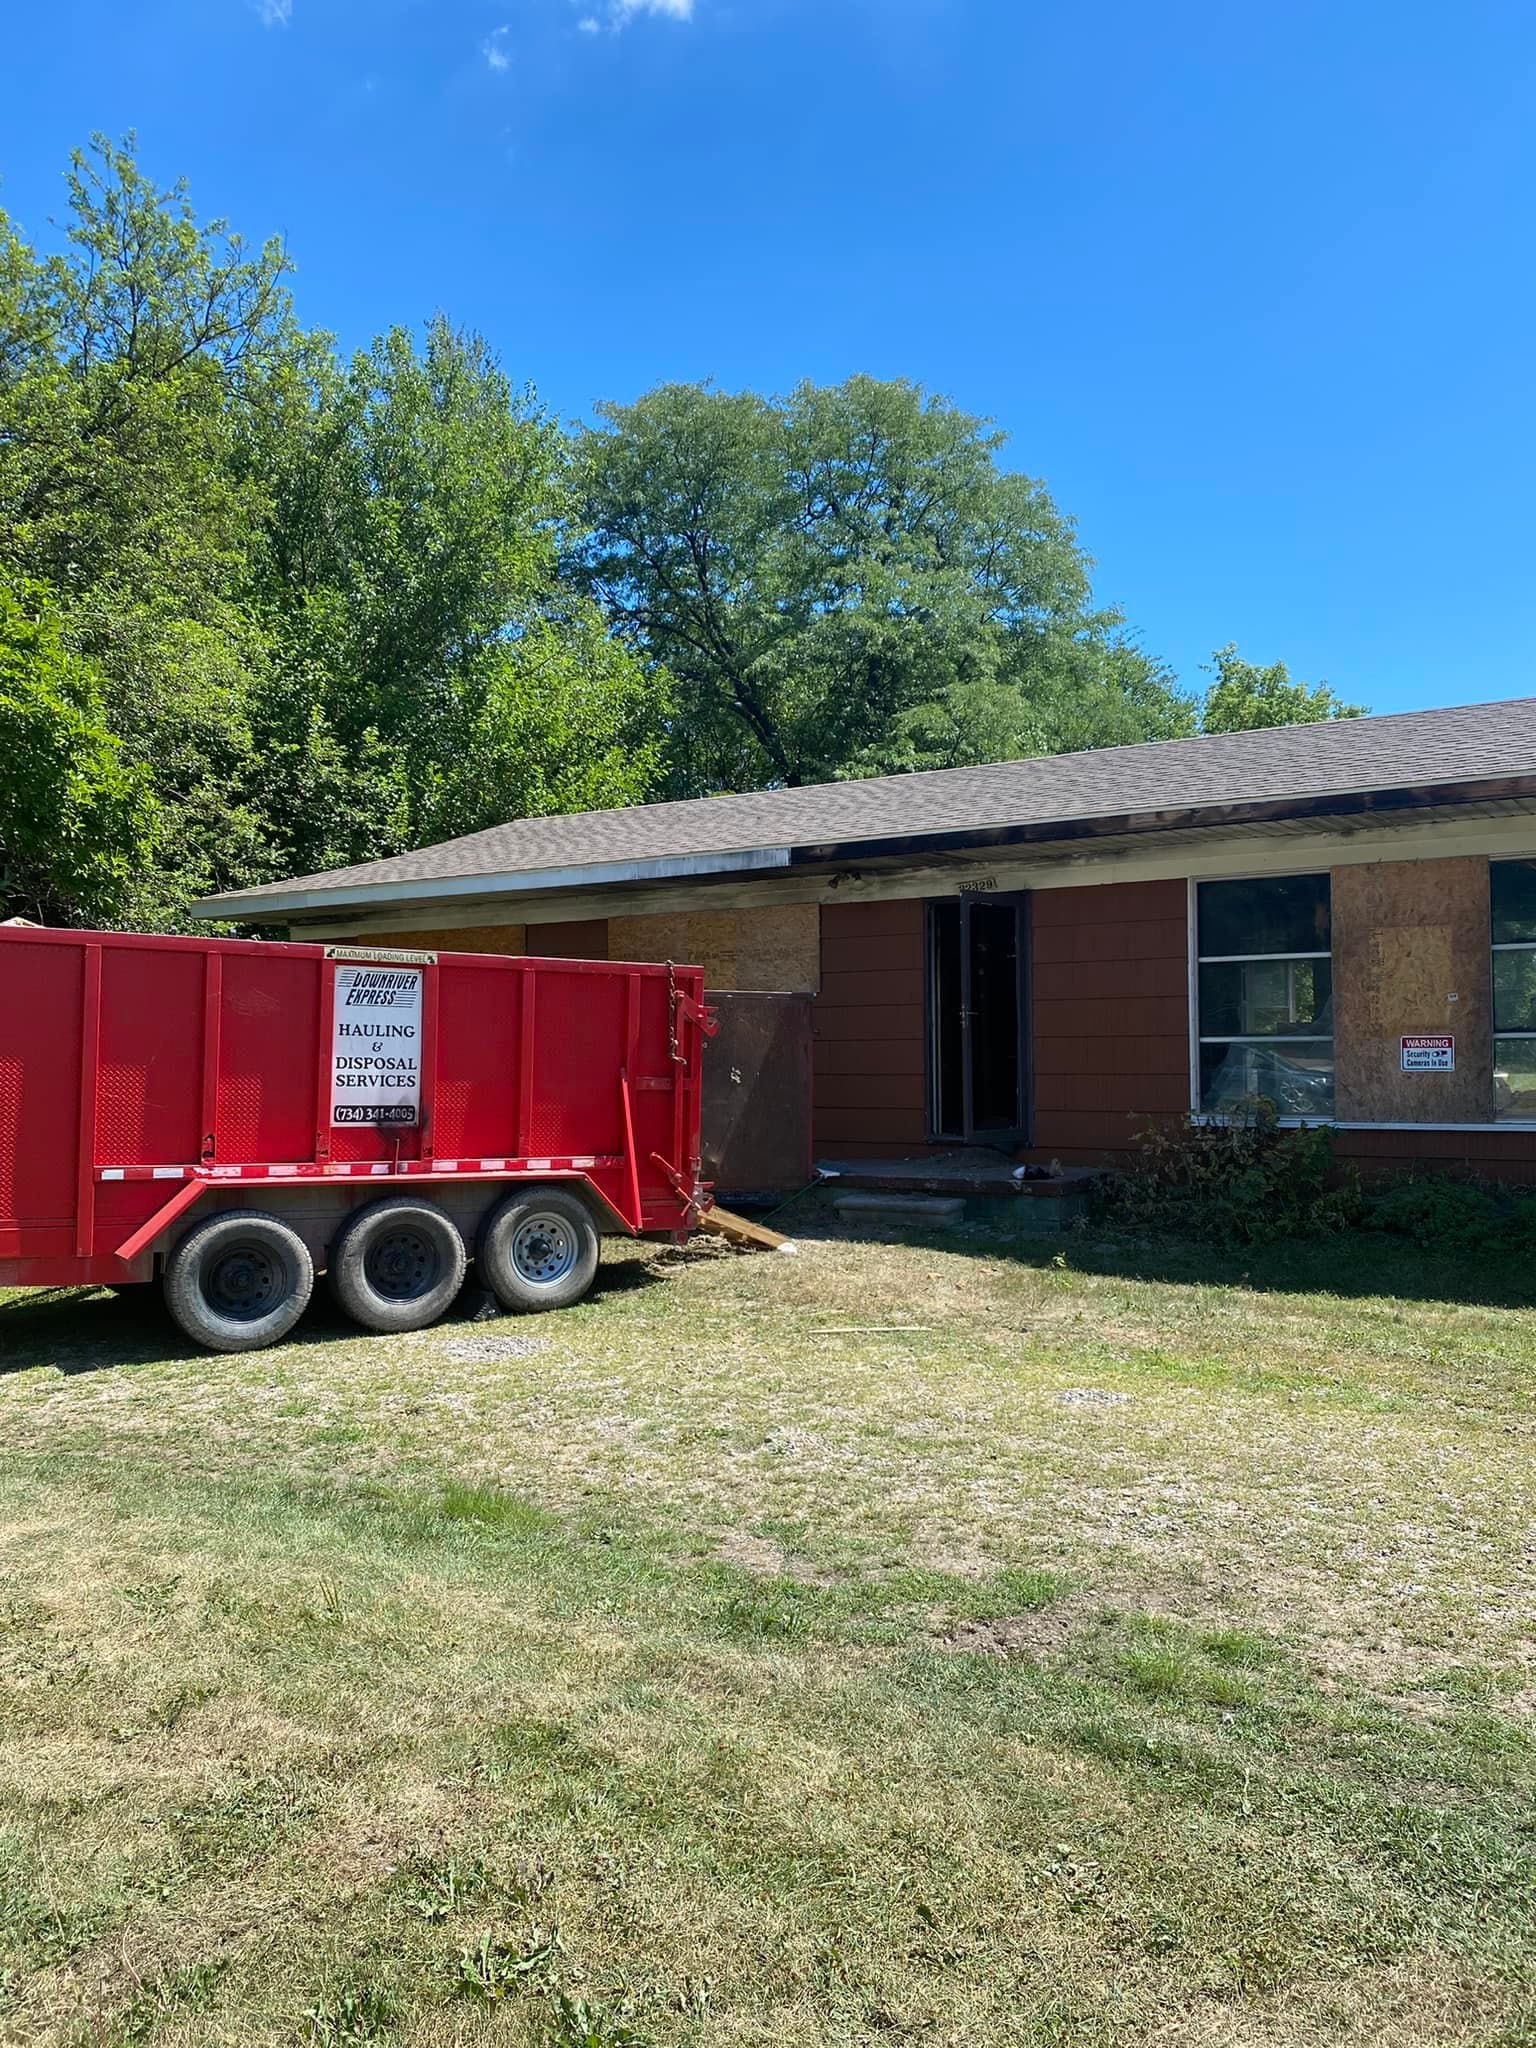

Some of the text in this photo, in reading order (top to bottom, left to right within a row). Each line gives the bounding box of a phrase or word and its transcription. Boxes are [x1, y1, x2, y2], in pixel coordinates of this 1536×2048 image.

[336, 949, 427, 963] MAXIMUM LOADING LEVEL
[353, 972, 418, 989] DOWNRIVER
[345, 989, 396, 1005] EXPRESS
[338, 1024, 415, 1037] HAULING
[372, 1042, 383, 1052] &
[1406, 1039, 1449, 1047] WARNING
[1406, 1050, 1430, 1059] Security
[336, 1057, 417, 1070] DISPOSAL
[1406, 1059, 1430, 1067] Cameras
[1438, 1059, 1448, 1067] Use
[336, 1075, 416, 1087] SERVICES
[336, 1107, 364, 1121] (734)
